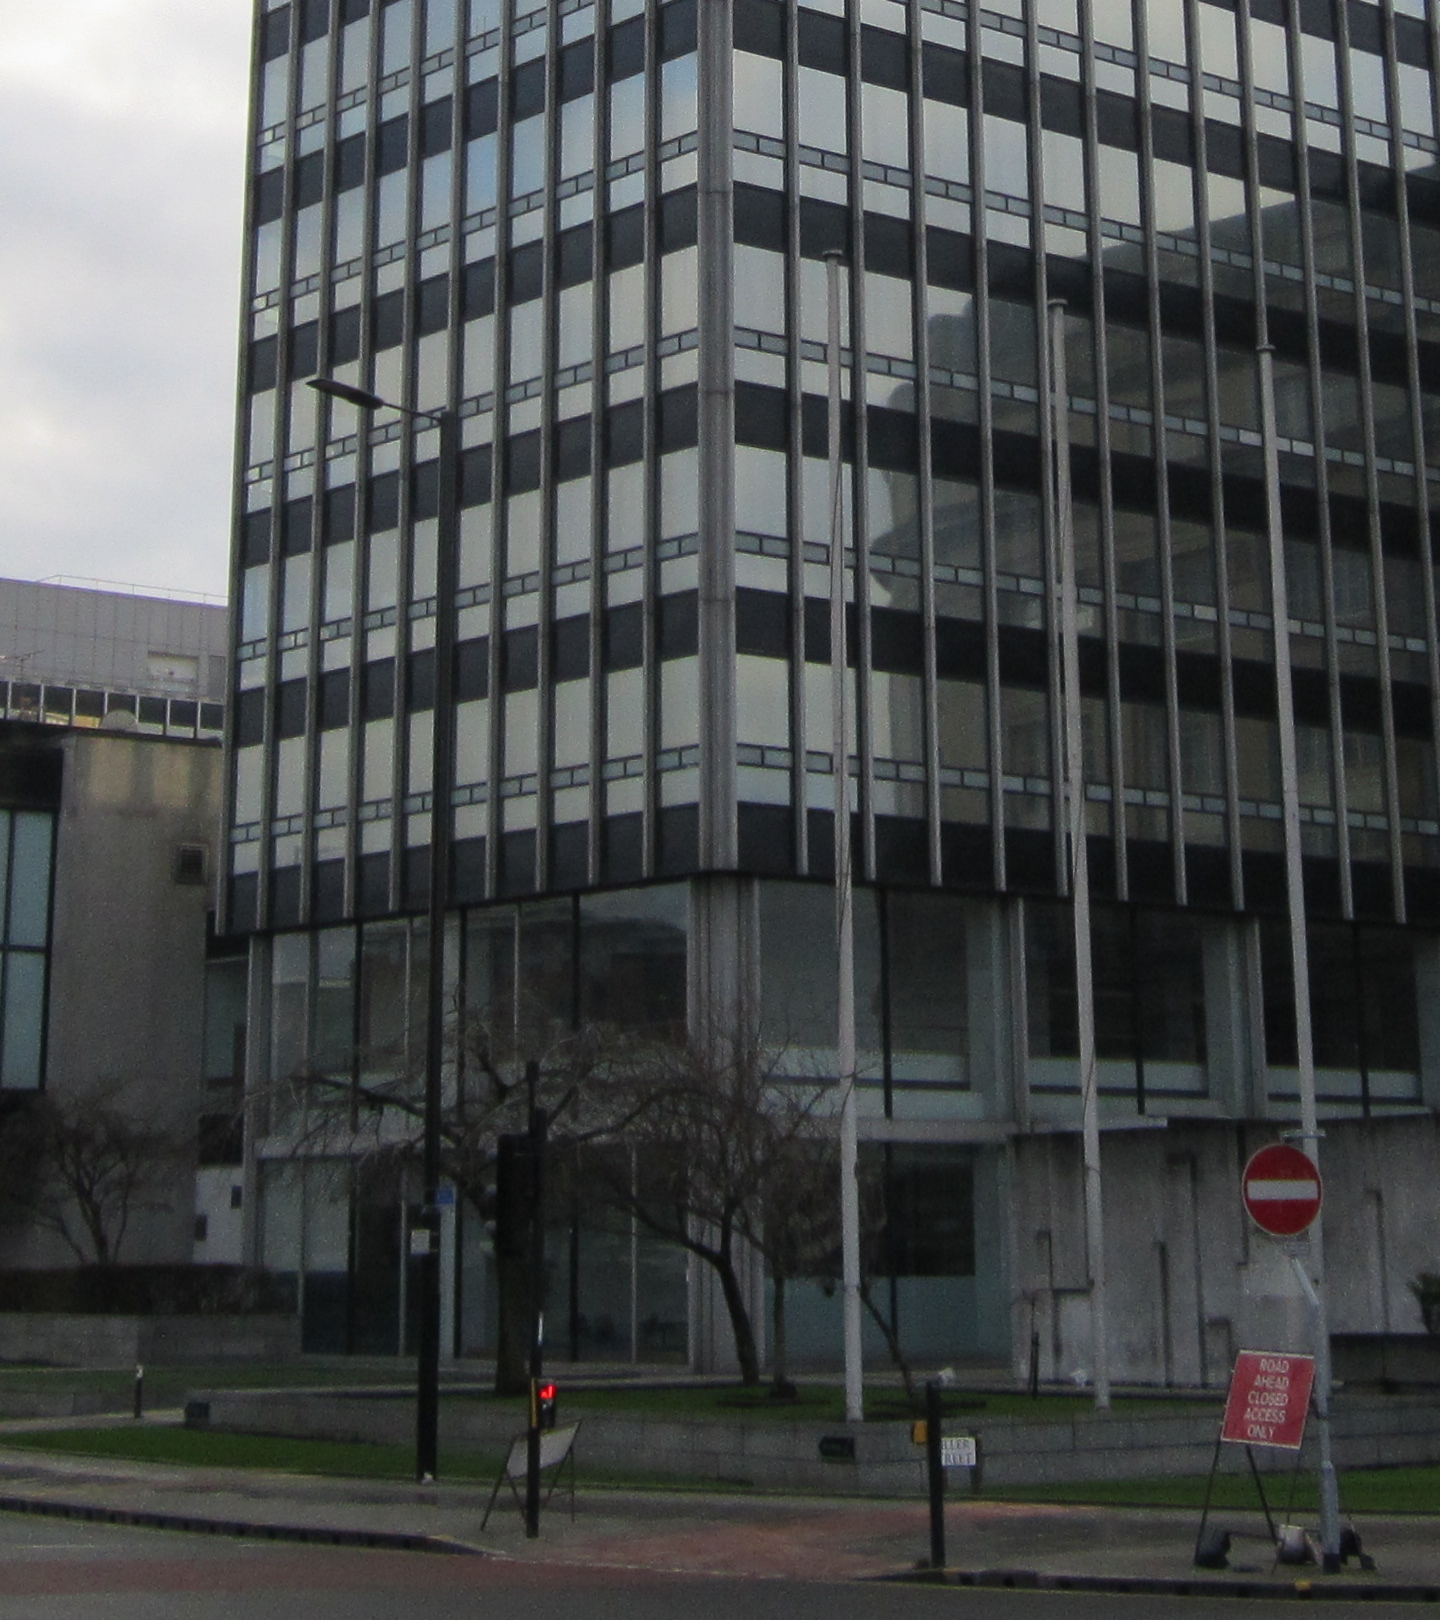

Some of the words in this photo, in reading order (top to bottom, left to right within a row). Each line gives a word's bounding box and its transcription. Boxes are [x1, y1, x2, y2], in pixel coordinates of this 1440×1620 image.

[1260, 1358, 1290, 1373] ROAD
[1254, 1374, 1289, 1390] AHEAD
[1247, 1390, 1289, 1406] CLOSED
[1243, 1407, 1286, 1423] ACCESS
[1247, 1424, 1276, 1438] ONLY
[944, 1439, 969, 1450] LLER
[944, 1452, 972, 1464] REET
